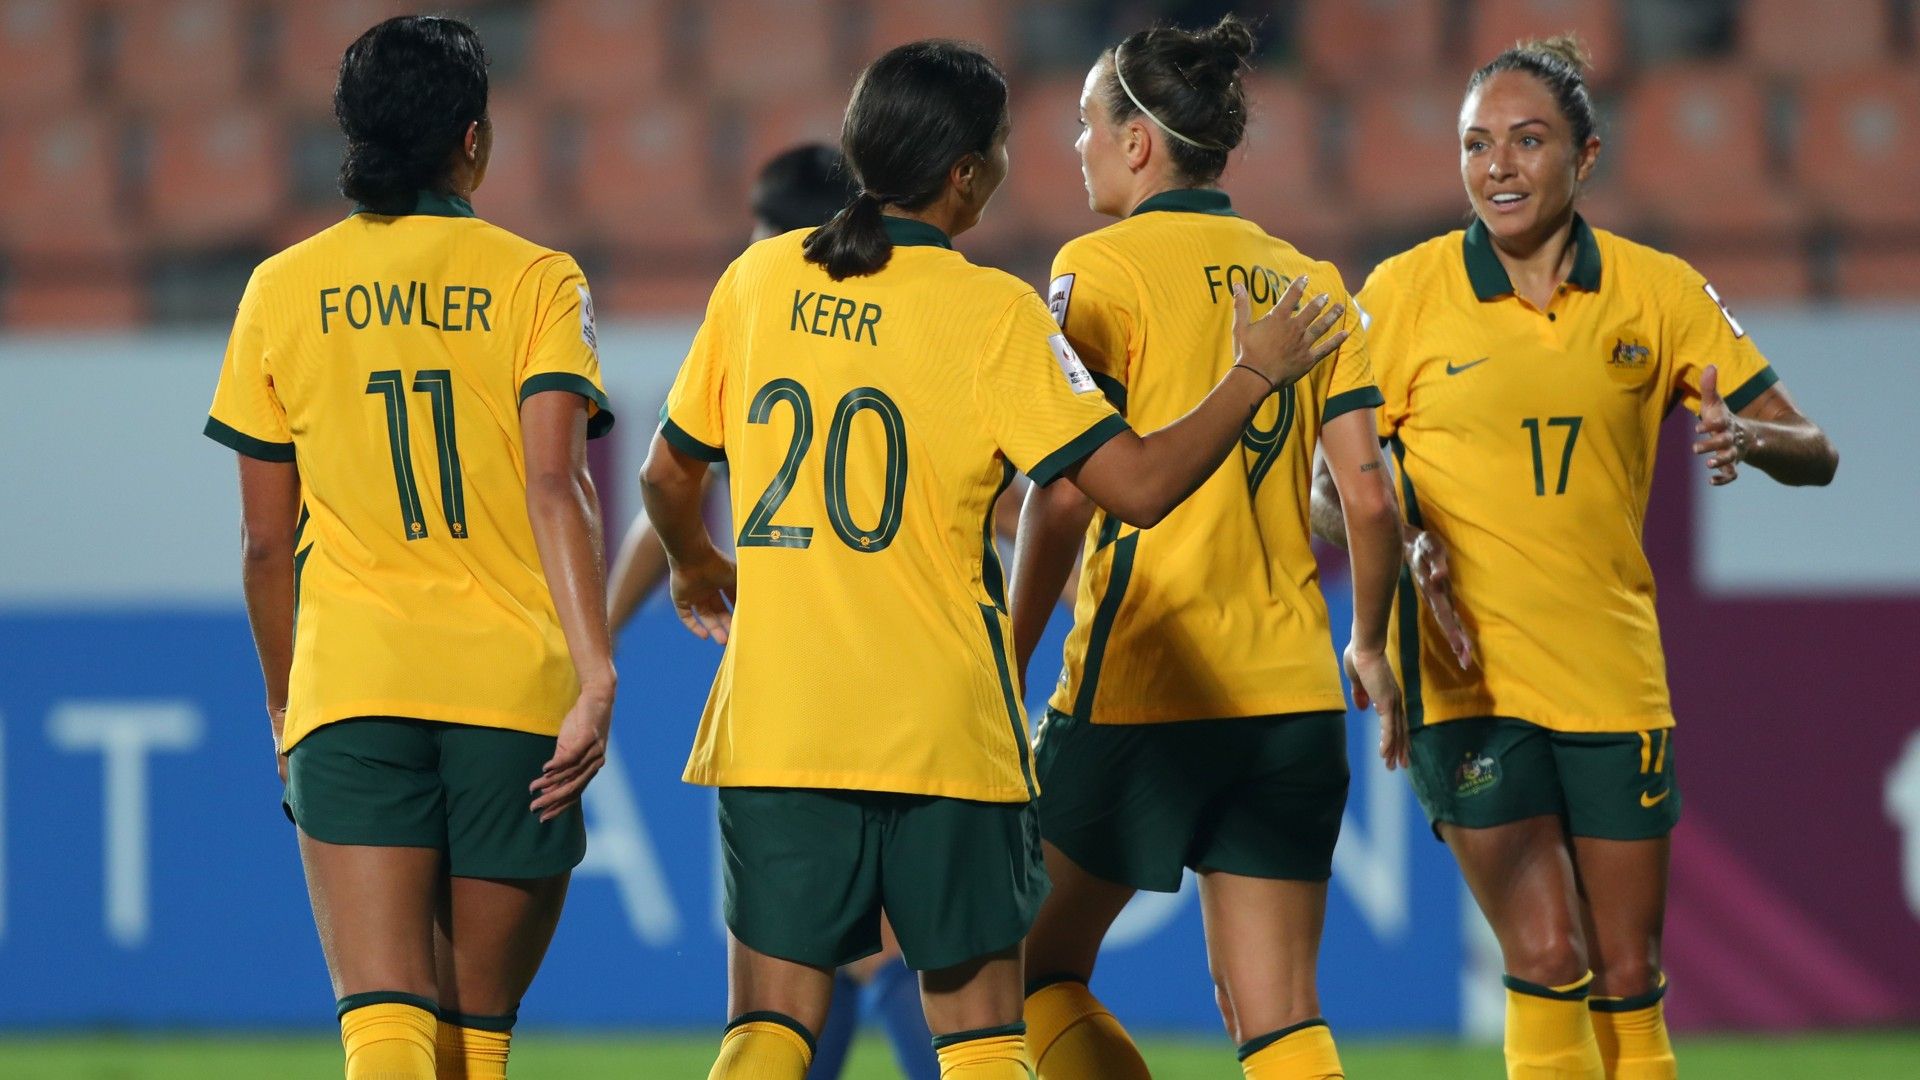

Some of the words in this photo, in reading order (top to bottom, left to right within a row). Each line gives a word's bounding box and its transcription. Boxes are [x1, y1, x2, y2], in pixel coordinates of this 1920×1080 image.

[320, 281, 492, 334] FOWLER
[790, 289, 882, 346] KERR
[365, 369, 469, 541] 11
[737, 378, 908, 553] 20
[1521, 416, 1583, 496] 17
